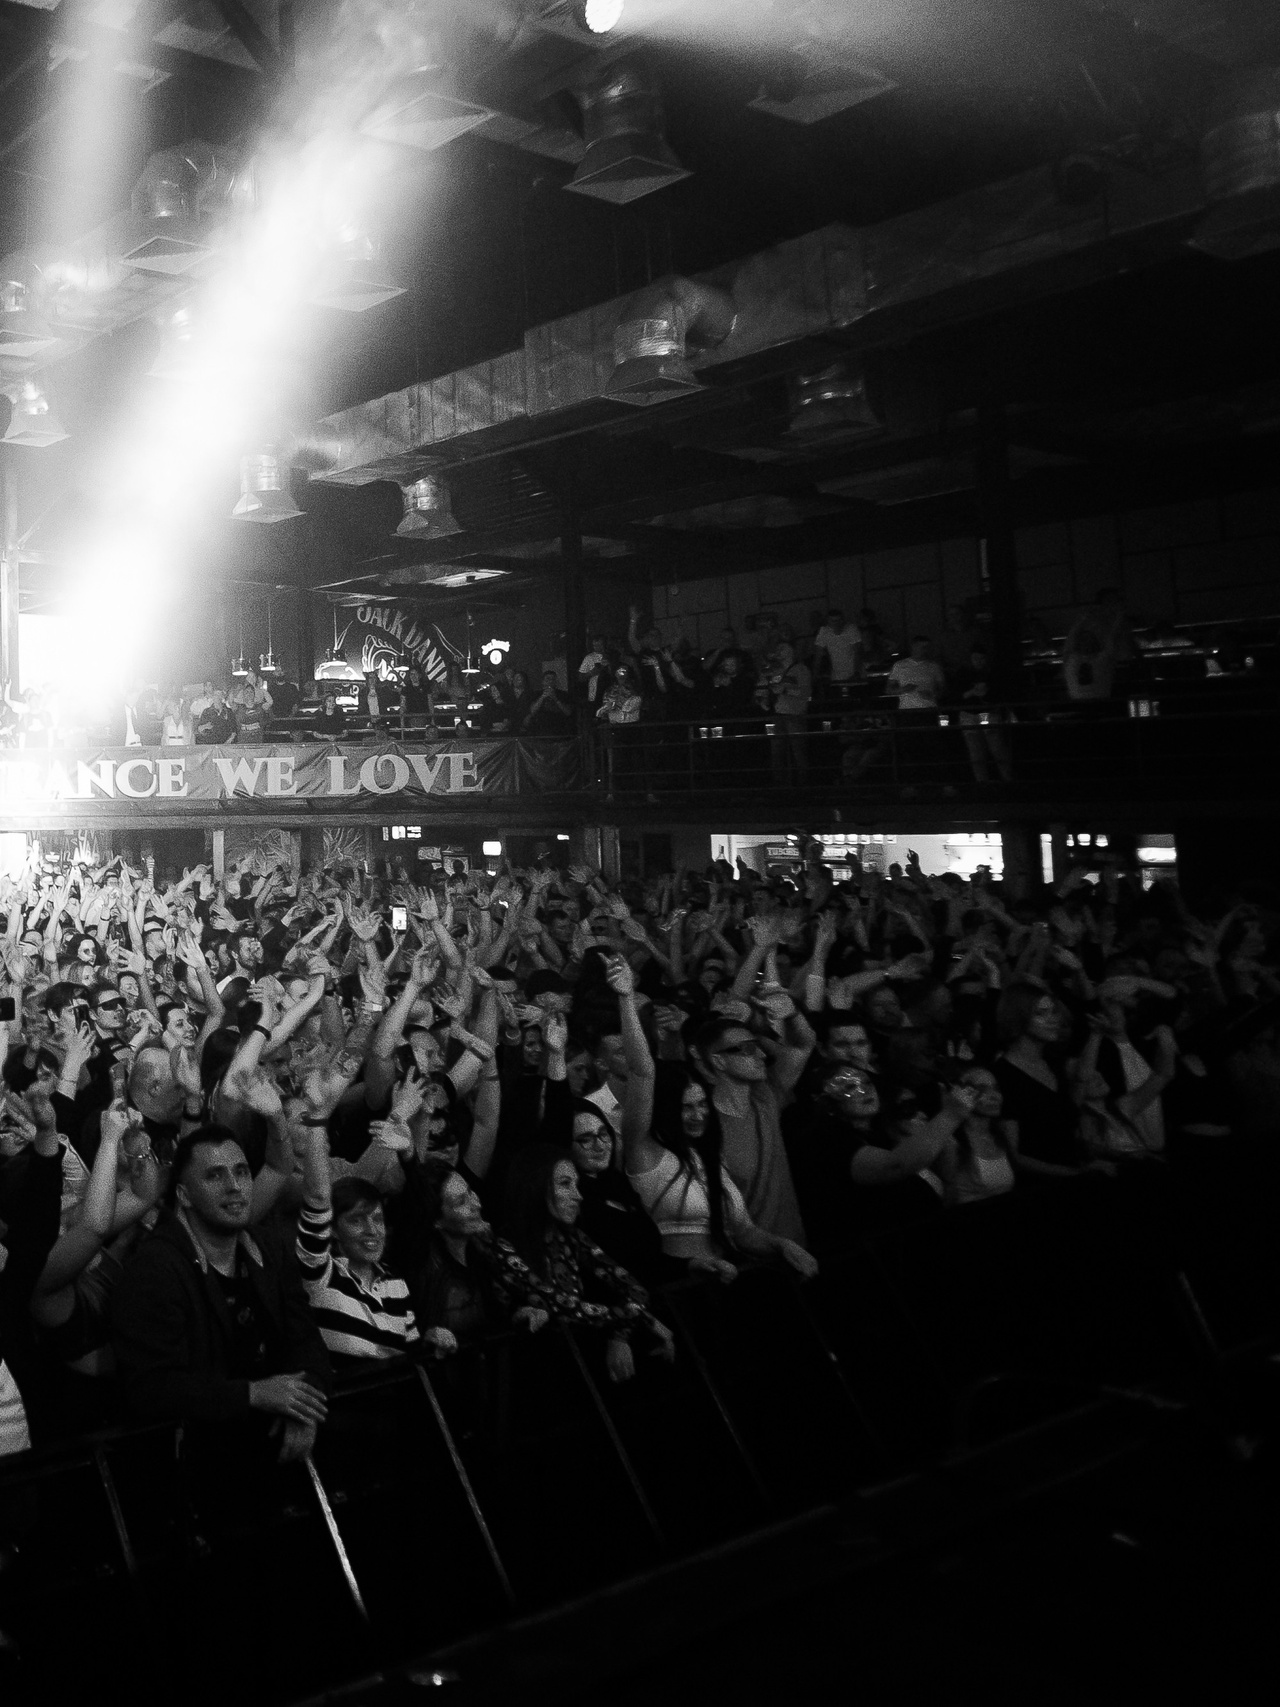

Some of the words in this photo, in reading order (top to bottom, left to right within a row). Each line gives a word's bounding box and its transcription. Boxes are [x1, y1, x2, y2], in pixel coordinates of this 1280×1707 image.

[357, 606, 407, 640] JACK
[212, 756, 298, 797] WE
[327, 752, 485, 795] LOVE
